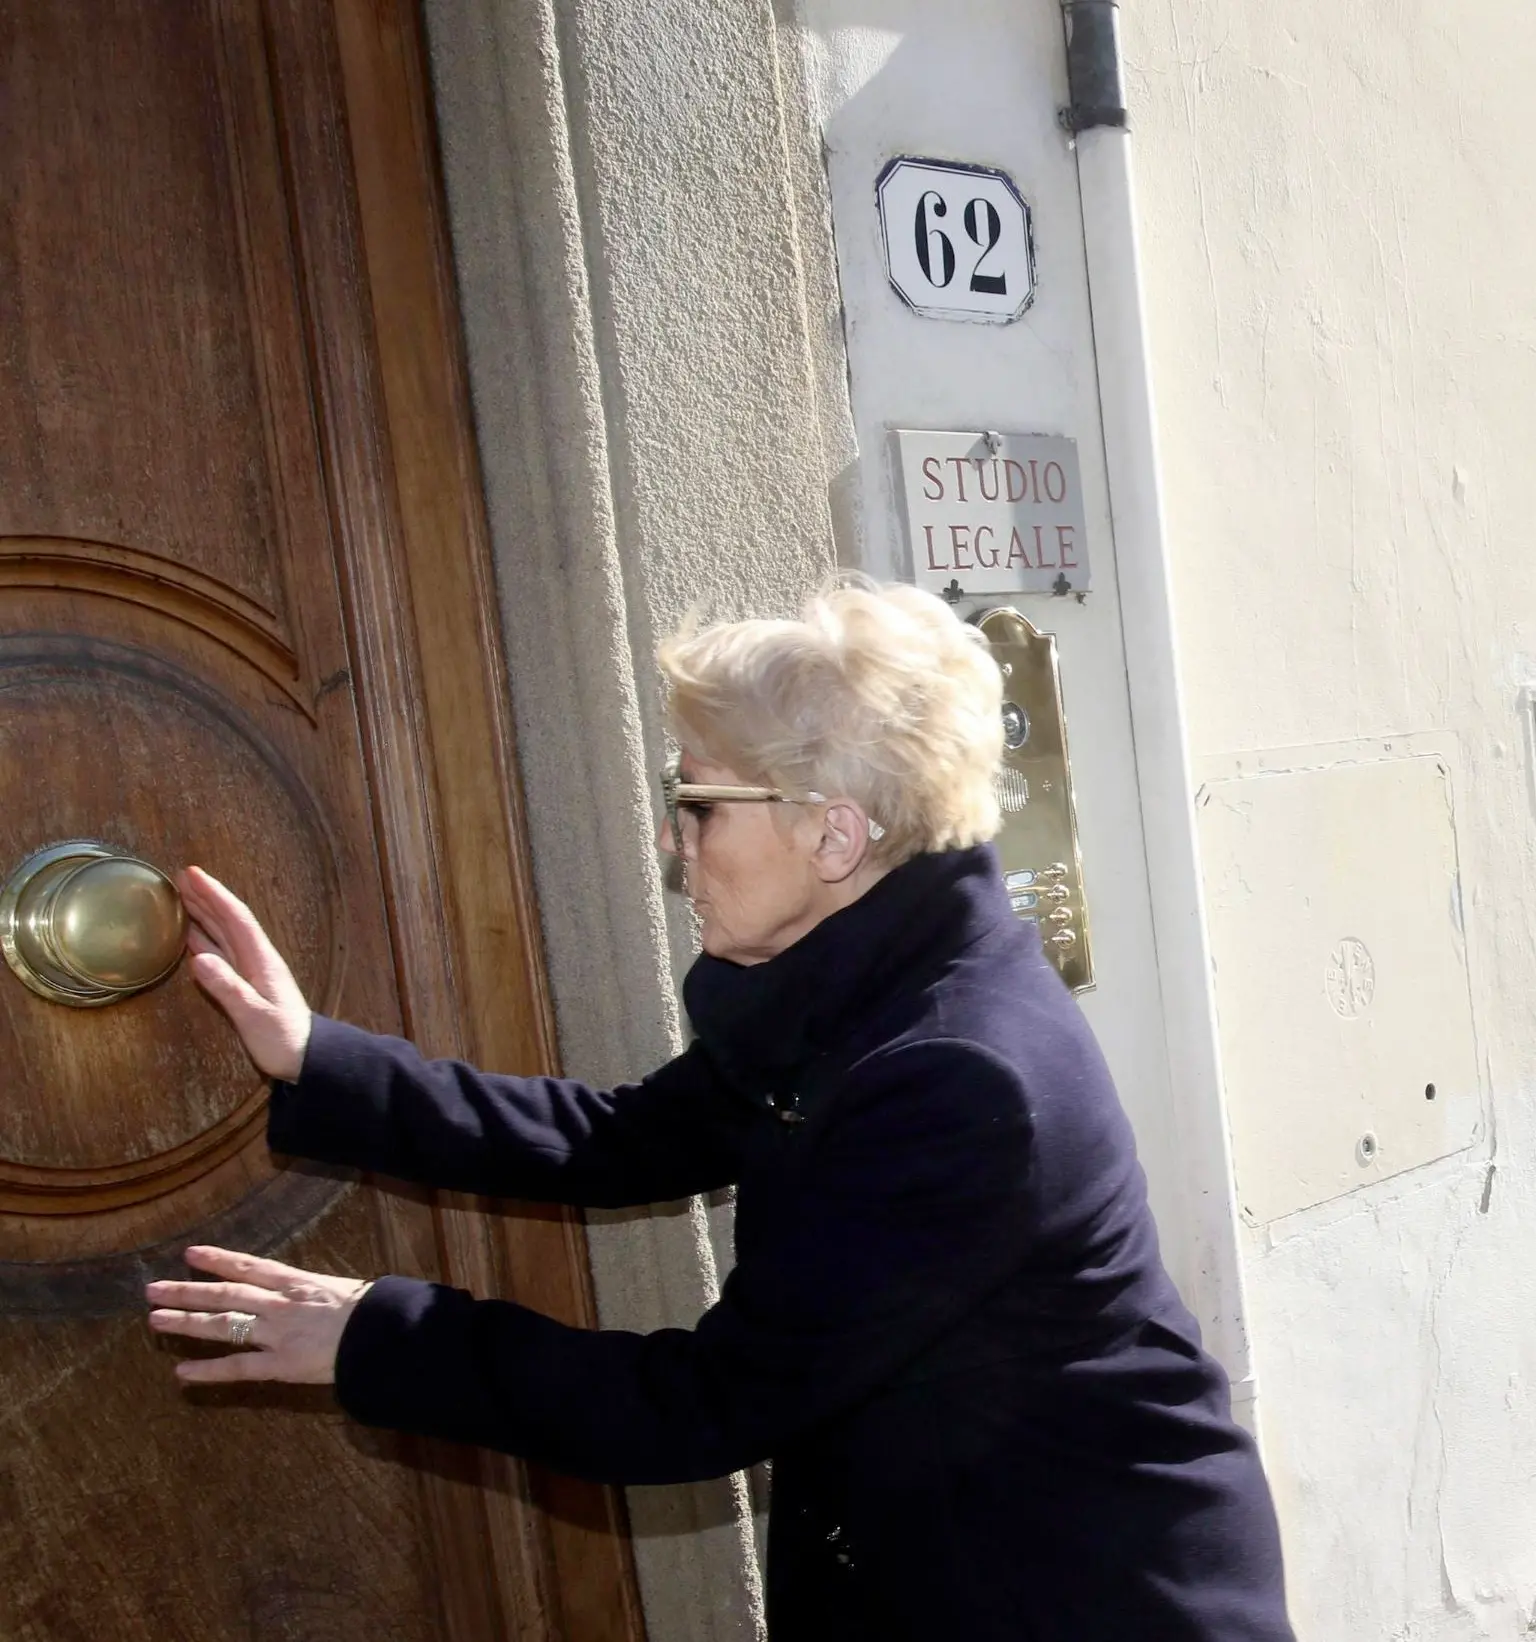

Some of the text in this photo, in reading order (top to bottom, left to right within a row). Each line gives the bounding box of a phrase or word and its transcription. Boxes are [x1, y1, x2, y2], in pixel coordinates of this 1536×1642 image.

[914, 190, 1008, 295] 62
[922, 456, 1067, 503] STUDIO
[922, 524, 1079, 571] LEGALE
